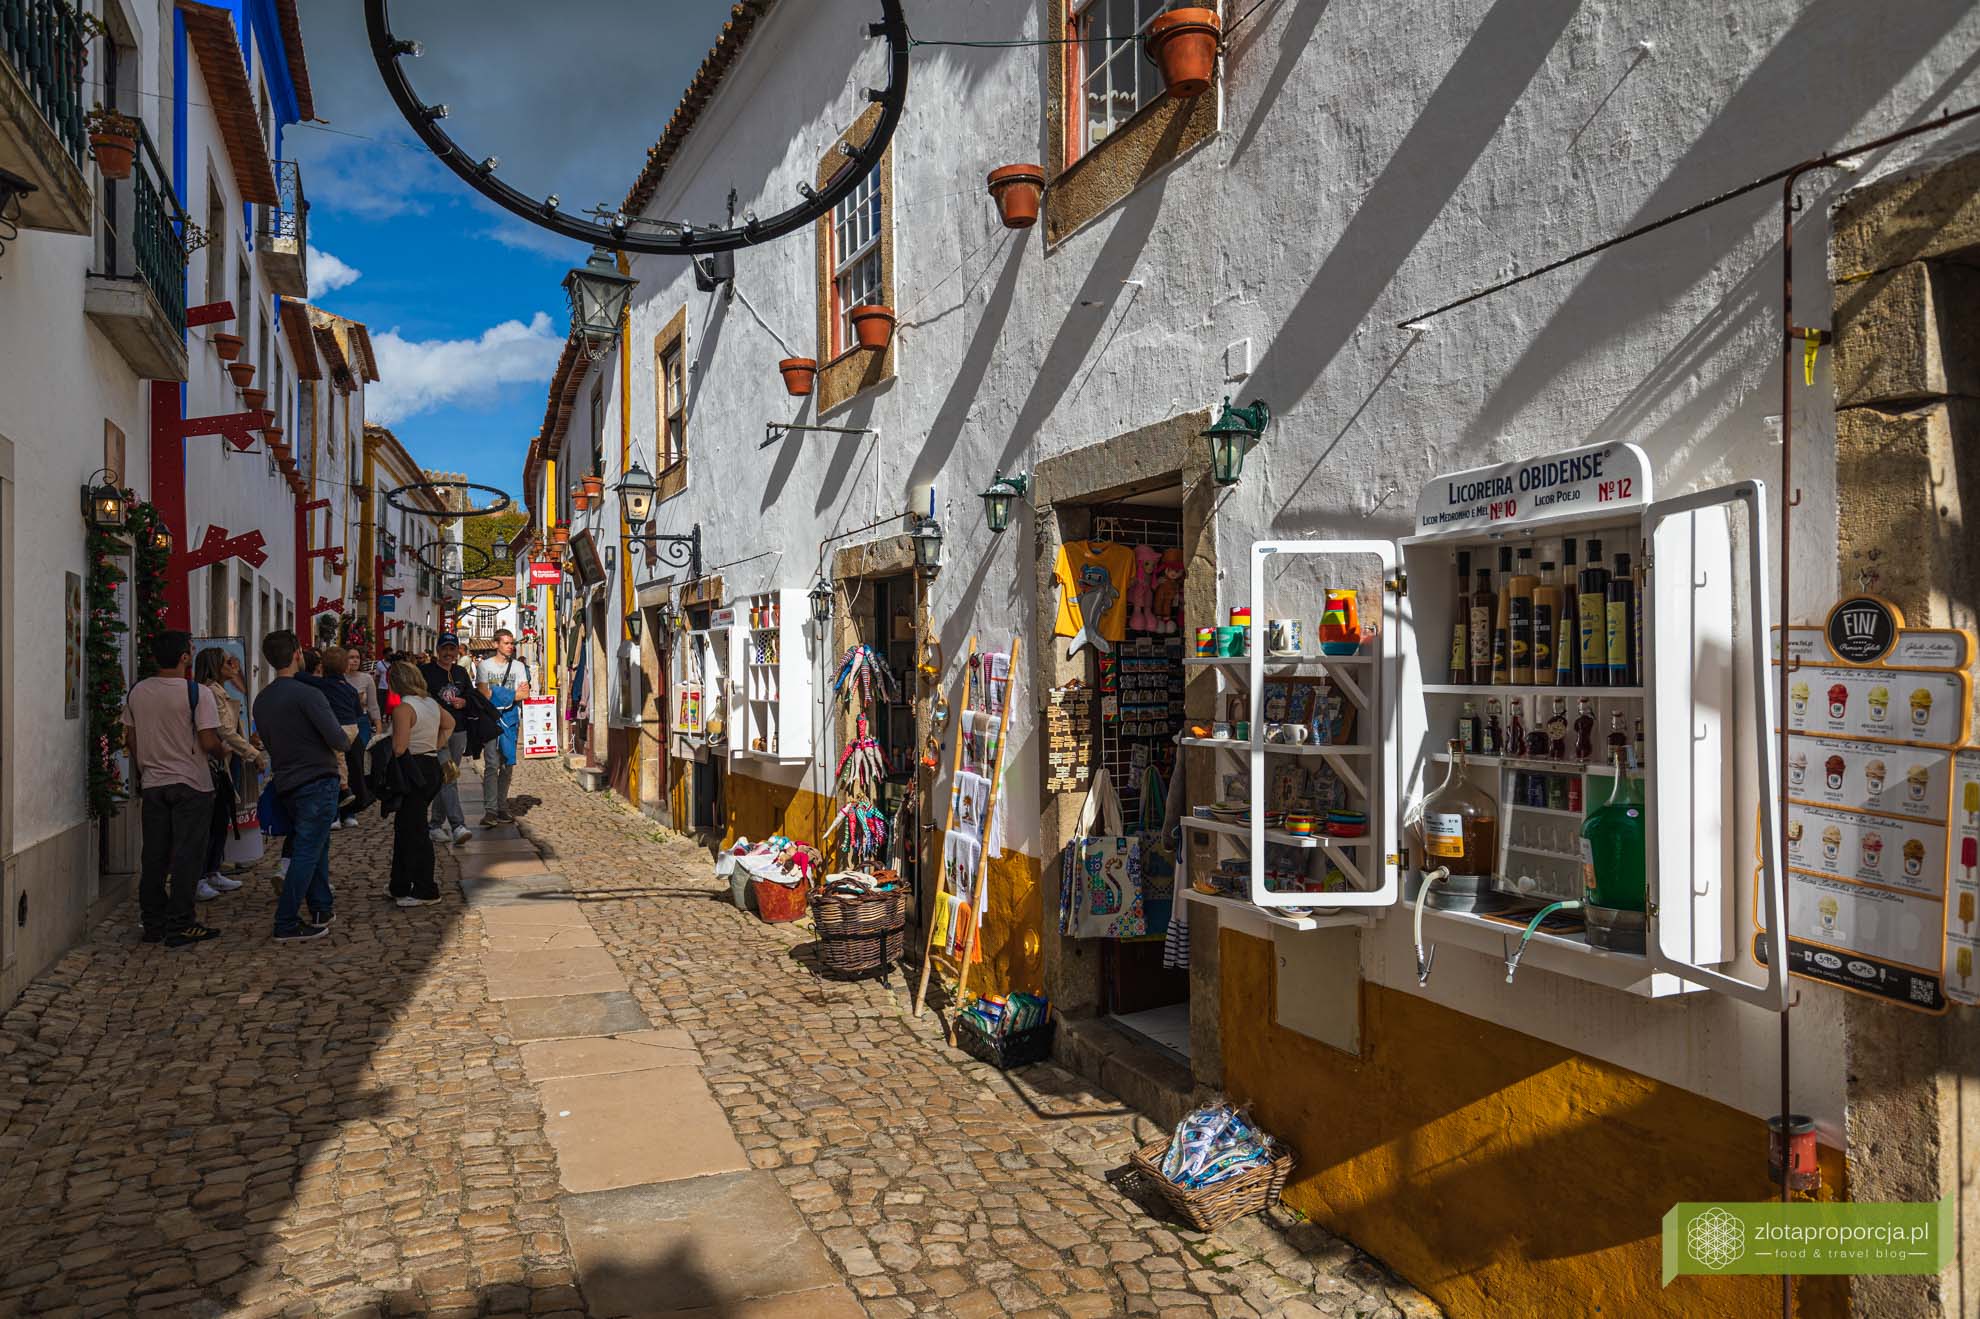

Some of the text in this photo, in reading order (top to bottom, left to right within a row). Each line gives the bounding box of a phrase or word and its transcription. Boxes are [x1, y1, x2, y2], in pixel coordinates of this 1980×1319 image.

[1448, 476, 1514, 504] LICOREIRA
[1534, 494, 1556, 507] LICOR
[1556, 489, 1581, 503] POEJO
[1616, 477, 1632, 499] 12
[1504, 499, 1517, 518] 10
[1842, 612, 1879, 636] FINI
